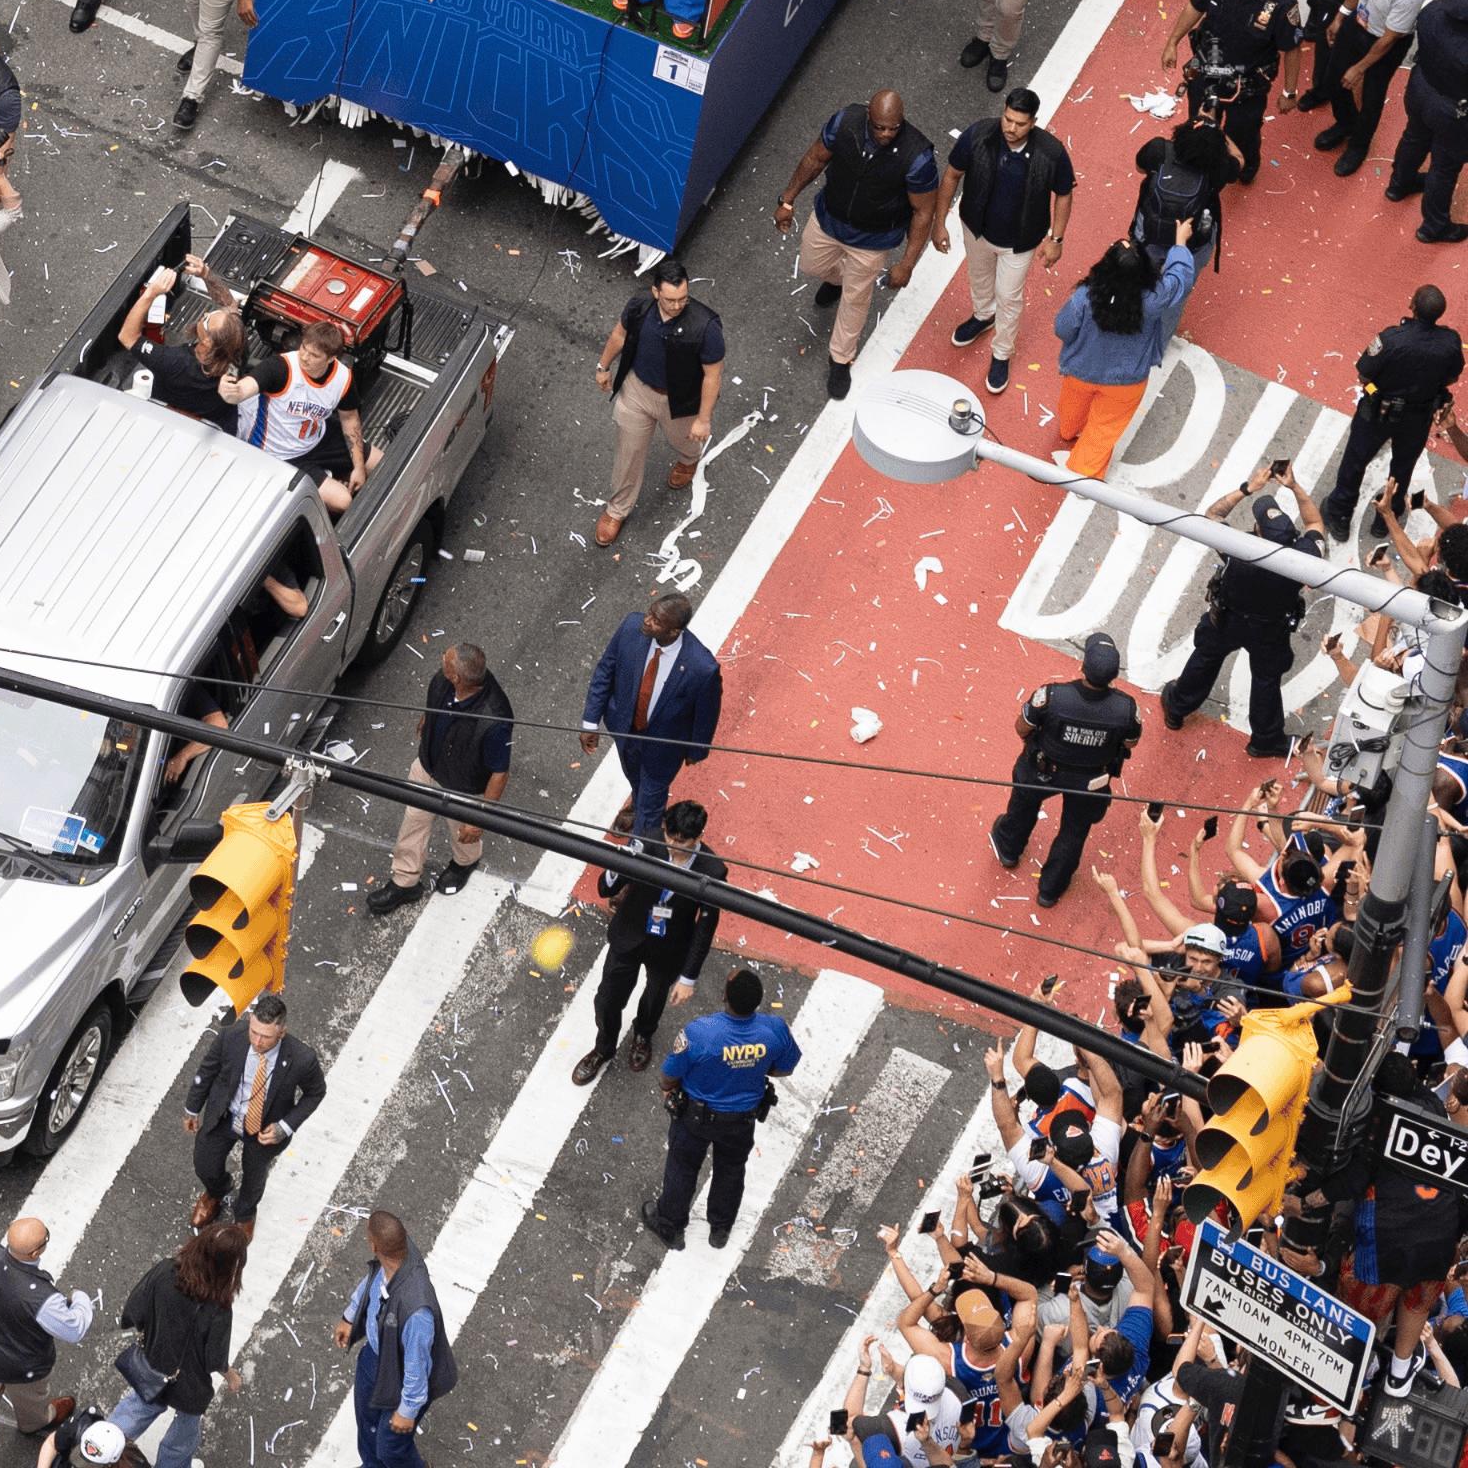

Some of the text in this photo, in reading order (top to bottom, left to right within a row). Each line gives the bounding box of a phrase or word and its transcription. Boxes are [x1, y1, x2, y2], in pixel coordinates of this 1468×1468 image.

[669, 64, 678, 81] 1
[1063, 732, 1105, 747] SHERIFF
[1275, 898, 1327, 933] ANUNOBY
[723, 1043, 767, 1062] NYPD
[1395, 1126, 1466, 1178] Dey
[1211, 1249, 1354, 1346] BUSES ONLY
[1229, 1277, 1325, 1343] & RIGHT TURNS
[1250, 1254, 1355, 1331] BUS LANE
[1204, 1276, 1344, 1375] 7AM-10AM 4PM-7PM
[1257, 1332, 1315, 1377] MON-FRI
